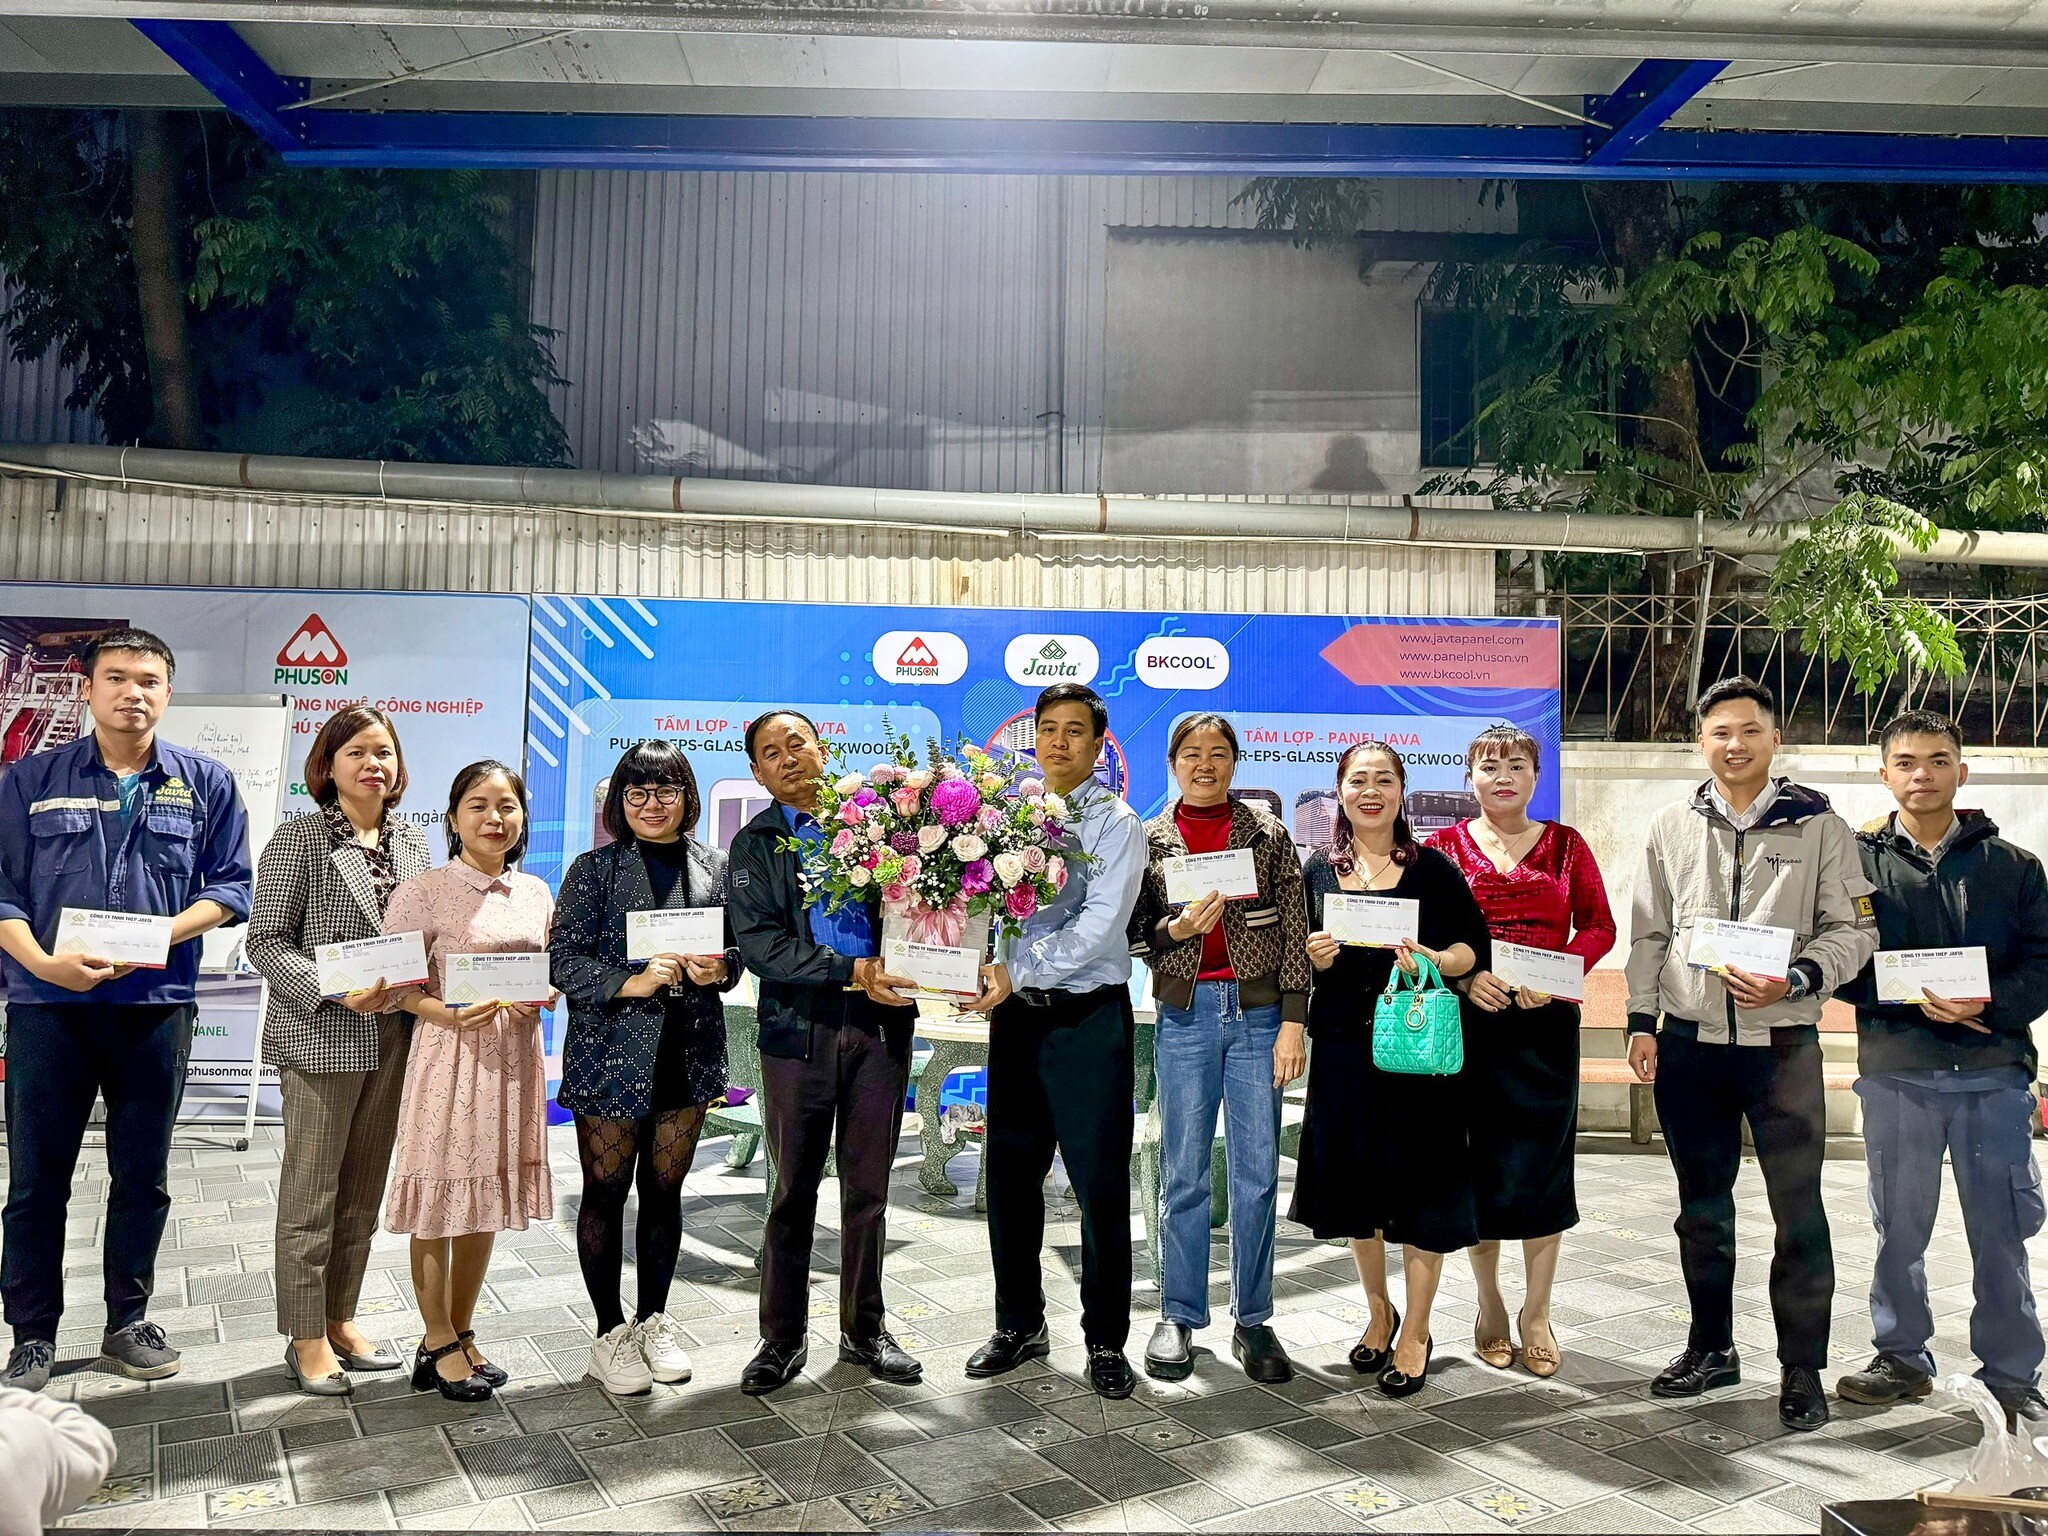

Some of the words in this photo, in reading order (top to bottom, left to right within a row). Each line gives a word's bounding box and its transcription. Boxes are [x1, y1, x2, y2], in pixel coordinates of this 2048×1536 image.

[1400, 633, 1524, 646] www.javtapanel.com
[1147, 655, 1216, 670] BKCOOL
[1400, 651, 1529, 664] www.panelphuson.vn
[895, 666, 939, 677] PHUSON
[1023, 657, 1080, 677] Javta
[274, 667, 348, 686] PHUSON
[1400, 669, 1491, 680] www.bkcool.vn
[375, 696, 422, 713] CÔNG
[425, 697, 483, 717] NGHIỆP
[654, 714, 690, 732] TẤM
[696, 719, 728, 735] LỢP
[815, 721, 847, 735] VTA
[1243, 726, 1278, 743] TẤM
[1284, 730, 1314, 746] LỢP
[193, 1025, 229, 1037] ANEL
